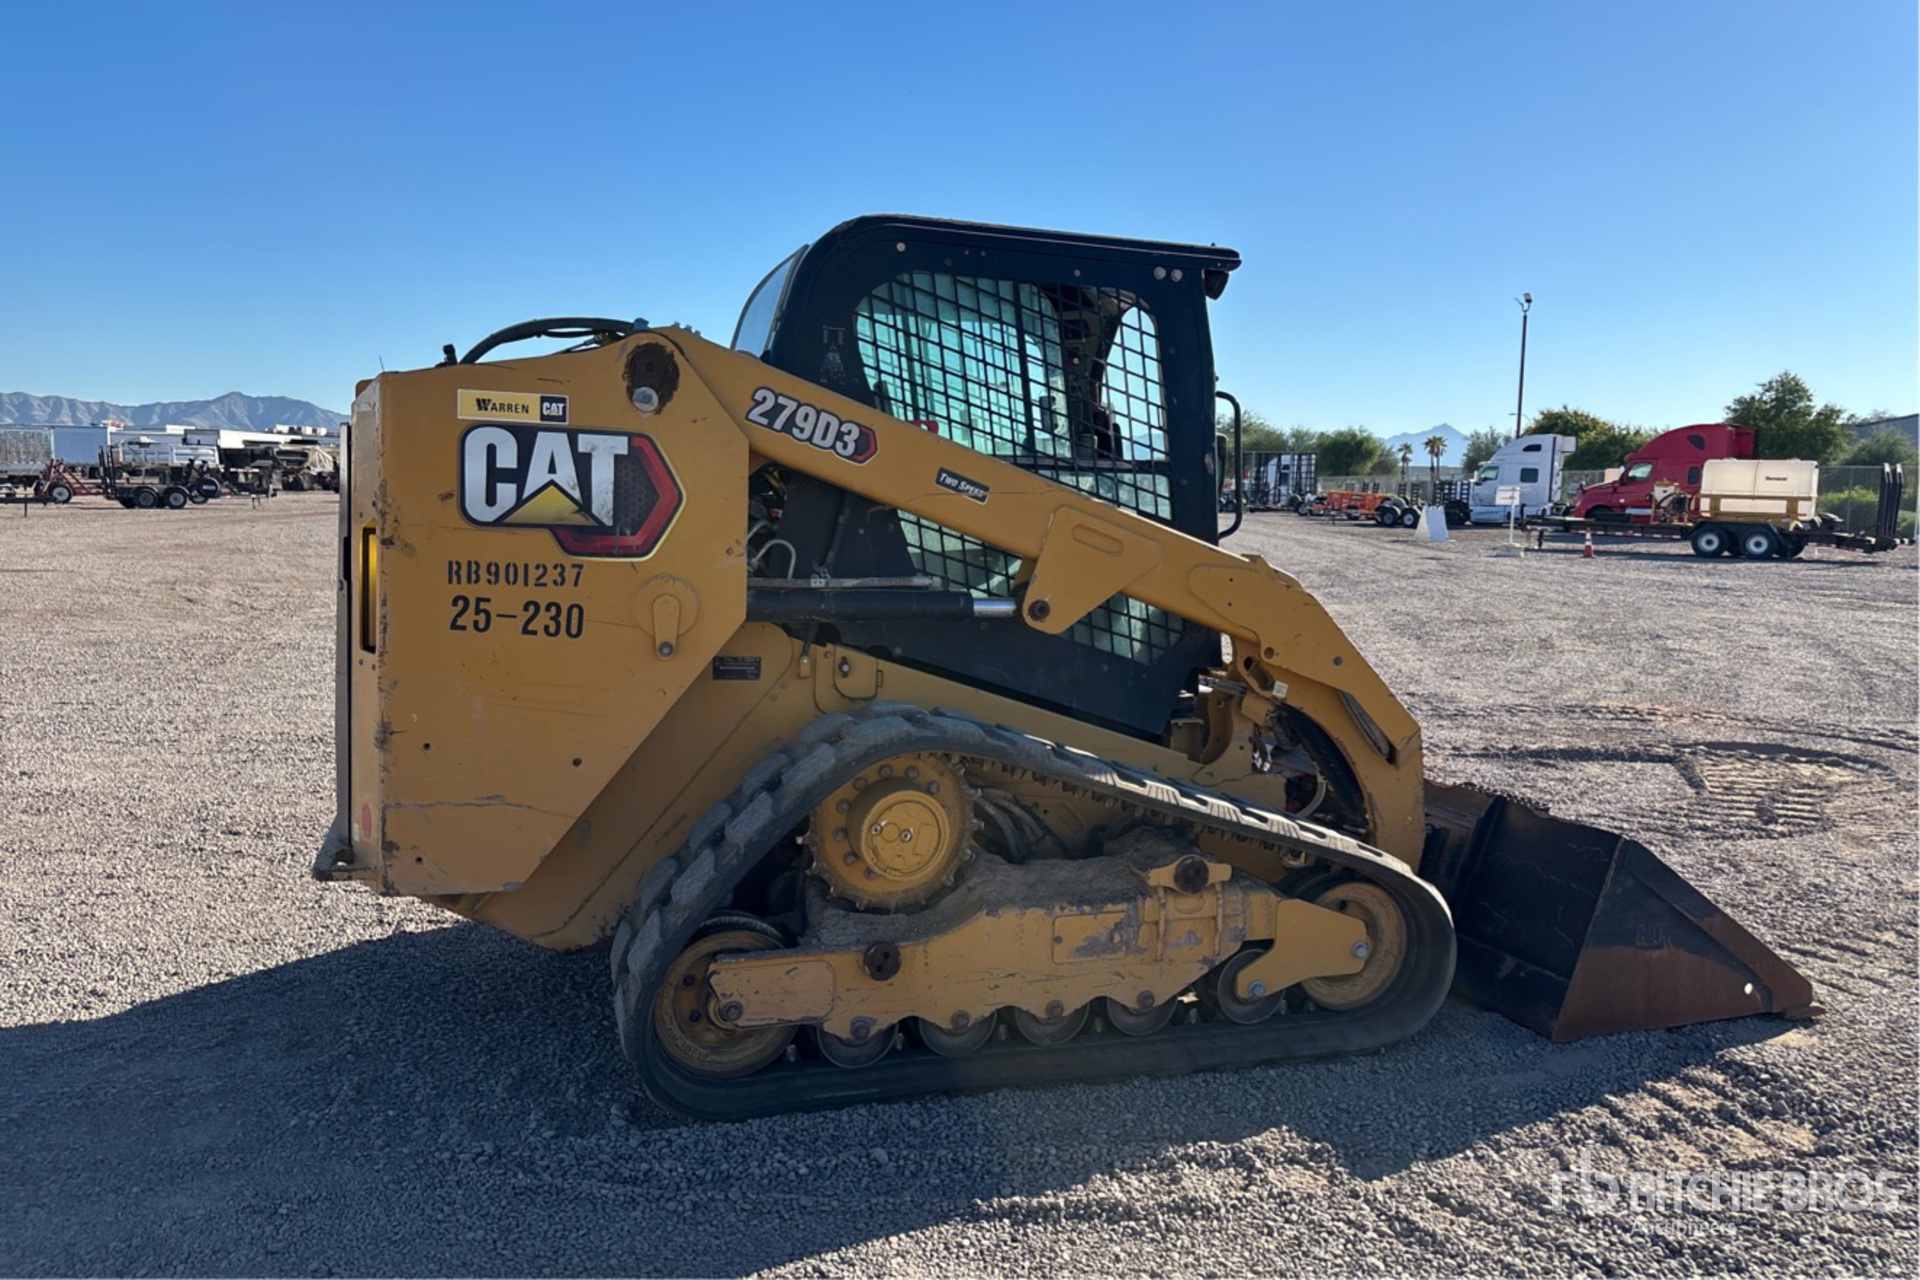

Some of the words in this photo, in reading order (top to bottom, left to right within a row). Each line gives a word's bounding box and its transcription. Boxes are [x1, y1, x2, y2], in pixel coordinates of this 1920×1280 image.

[475, 398, 530, 414] WARREN
[542, 402, 566, 416] CAT
[746, 387, 861, 457] 279D3
[464, 426, 629, 527] CAT
[447, 560, 584, 588] RB901237
[449, 594, 585, 639] 25-230
